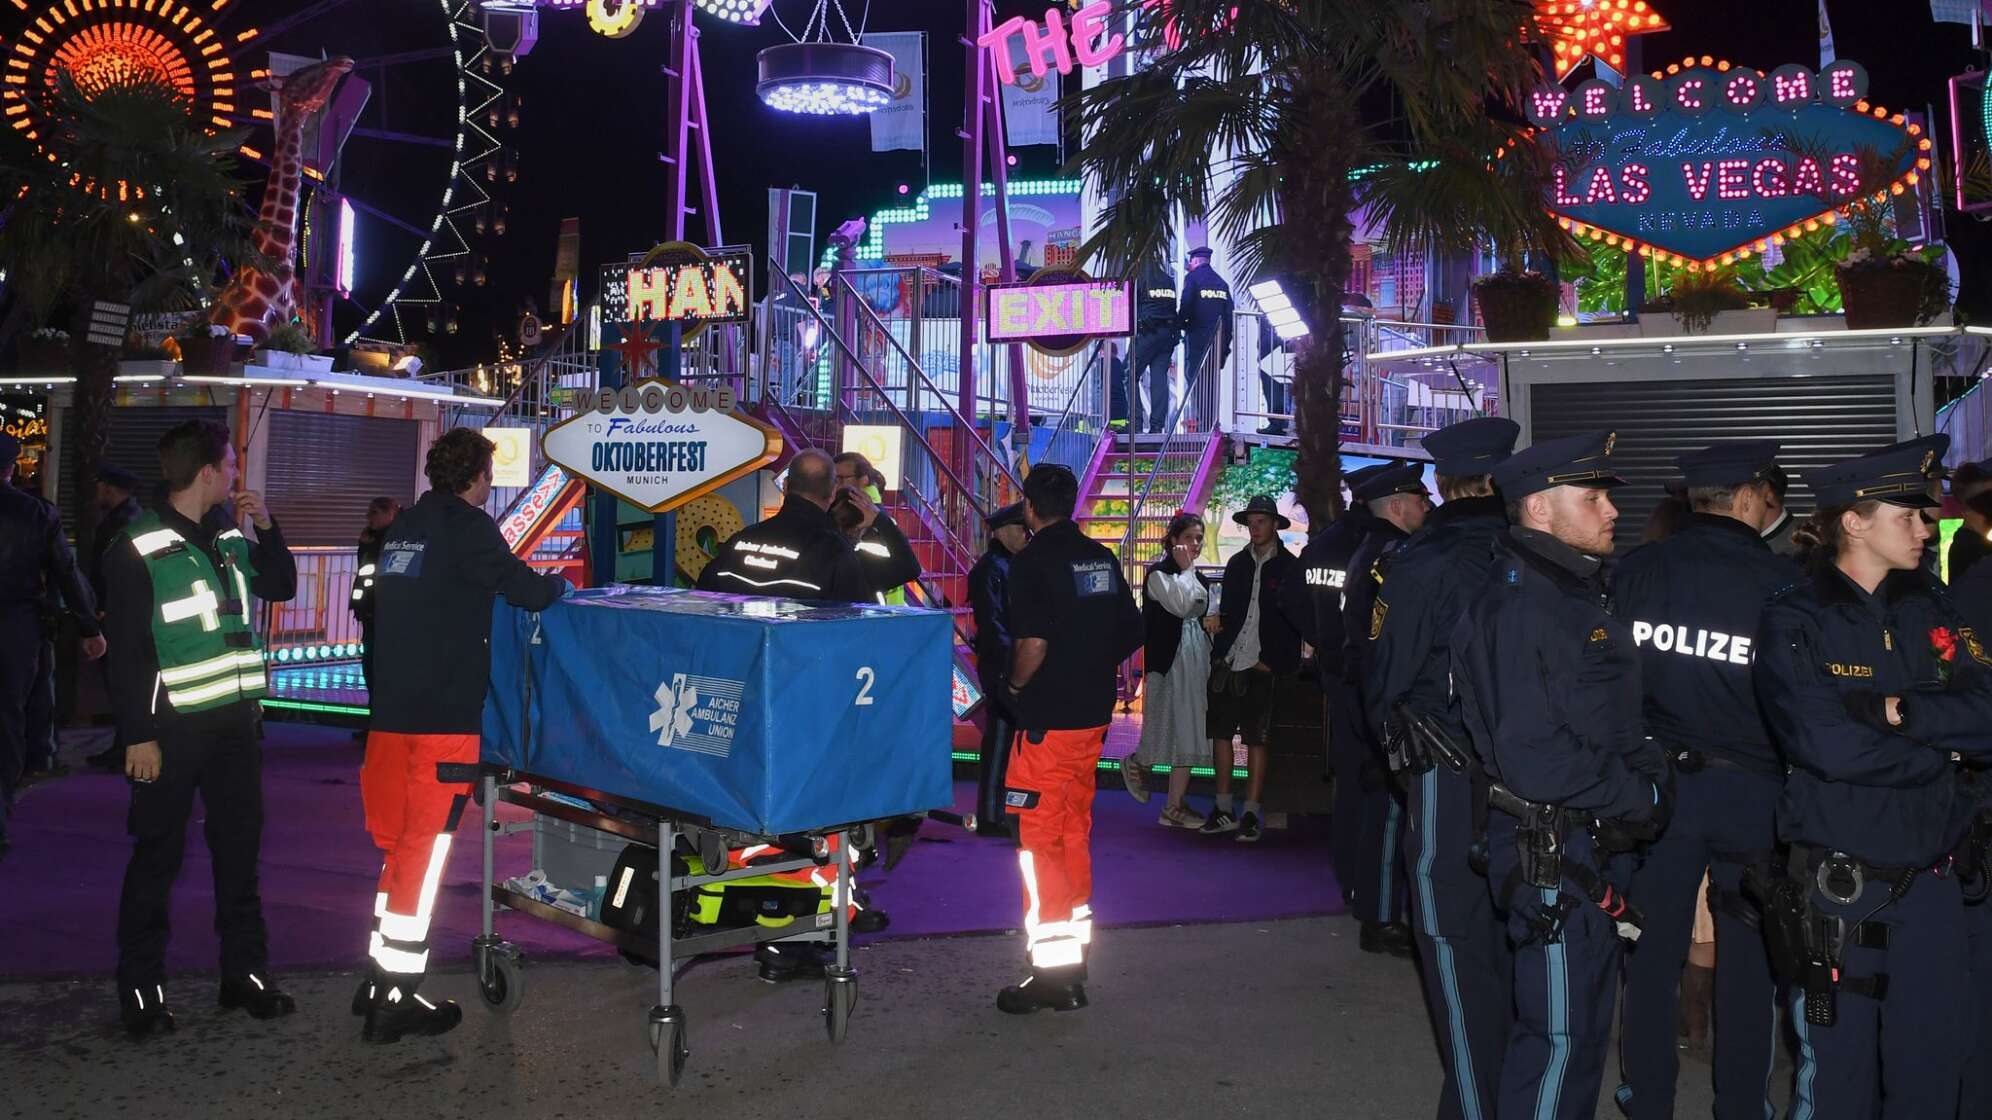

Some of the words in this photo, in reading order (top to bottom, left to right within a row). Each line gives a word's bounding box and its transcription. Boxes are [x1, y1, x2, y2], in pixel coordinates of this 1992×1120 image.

[978, 1, 1123, 84] THE
[1533, 69, 1855, 118] WELCOME
[1612, 127, 1786, 165] Fabulous
[1555, 164, 1650, 206] LAS
[1682, 154, 1860, 201] VEGAS
[1639, 208, 1768, 232] NEVADA
[1200, 288, 1227, 299] POLIZE
[1000, 289, 1123, 332] EXIT
[576, 391, 729, 409] WELCOME
[587, 423, 601, 433] TO
[606, 417, 700, 438] Fabulous
[592, 440, 707, 472] OKTOBERFEST
[626, 475, 669, 485] MUNICH
[1306, 567, 1346, 587] POLIZE
[1633, 620, 1752, 665] POLIZE
[855, 666, 875, 705] 2
[708, 697, 740, 712] AICHER
[691, 708, 738, 726] AMBULANZ
[708, 724, 735, 739] UNION
